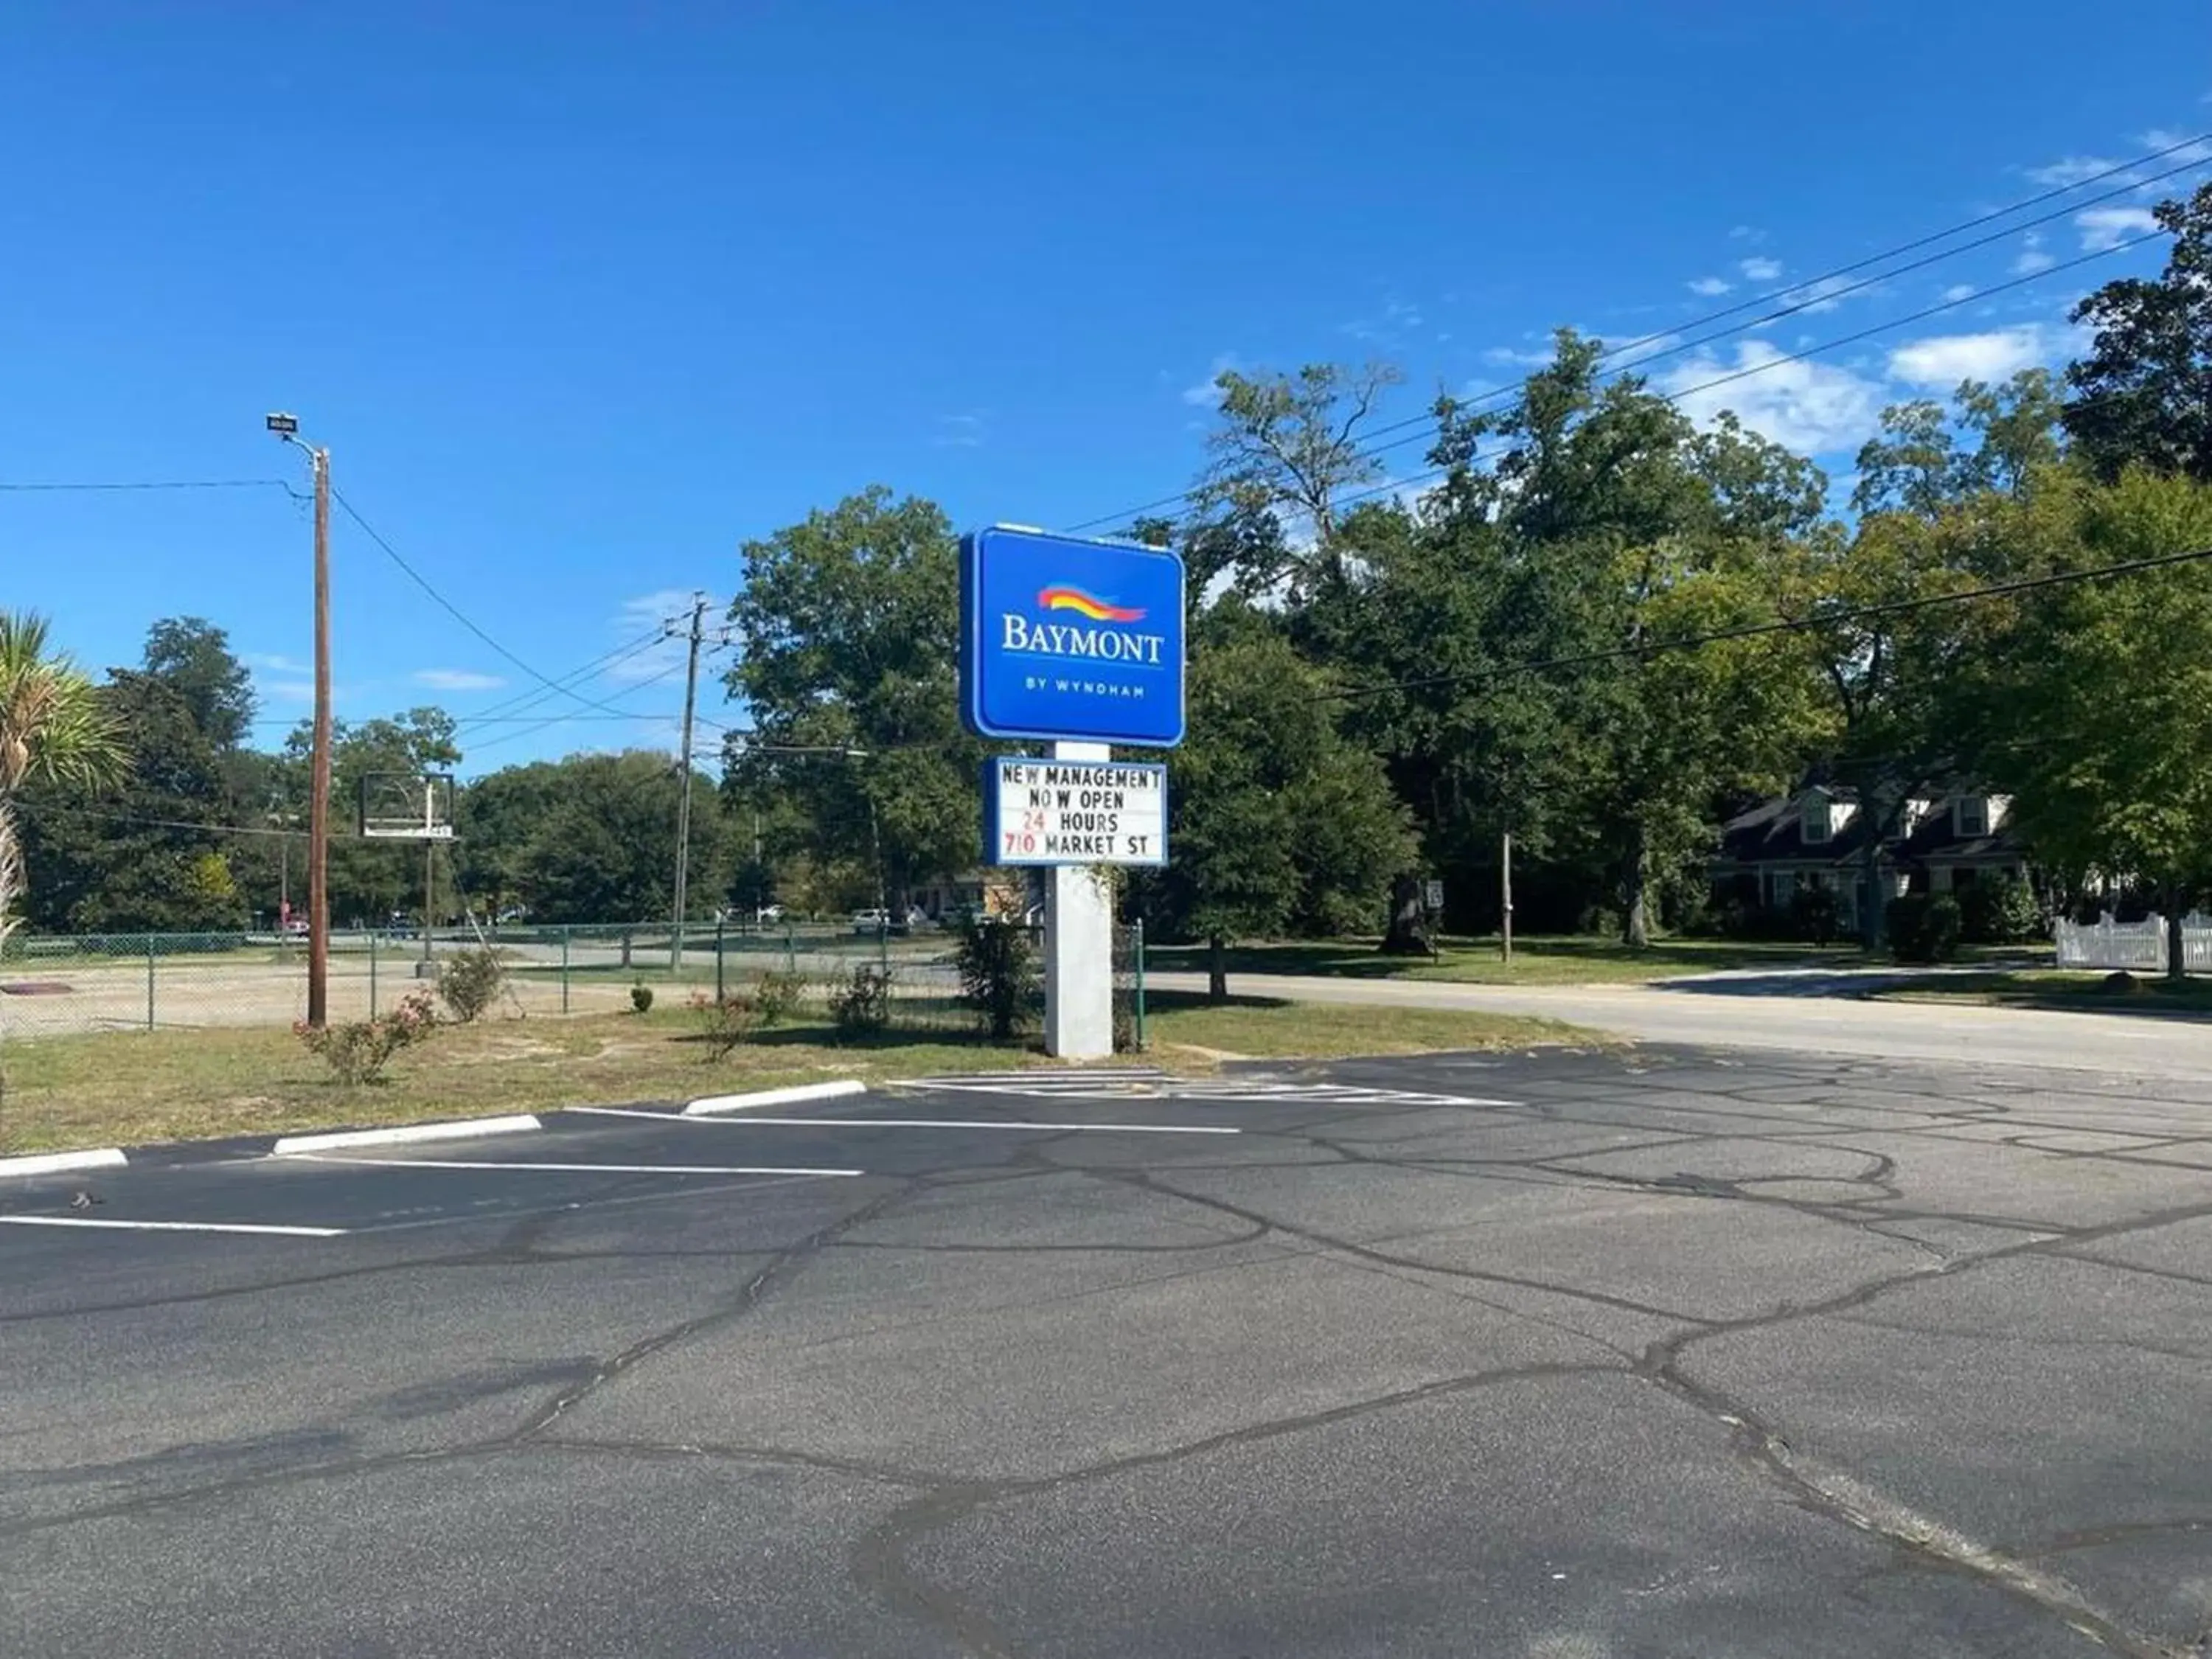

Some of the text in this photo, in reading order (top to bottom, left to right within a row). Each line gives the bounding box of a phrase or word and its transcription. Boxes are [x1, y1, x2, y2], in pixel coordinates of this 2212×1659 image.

[1002, 613, 1164, 664] BAYMONT
[1026, 677, 1144, 698] BY WYNDHAM
[1003, 765, 1160, 788] NEW MANAGEMENT
[1029, 790, 1124, 809] NOW OPEN
[1023, 812, 1118, 832] 24 HOURS
[1005, 832, 1148, 855] 710 MARKET ST
